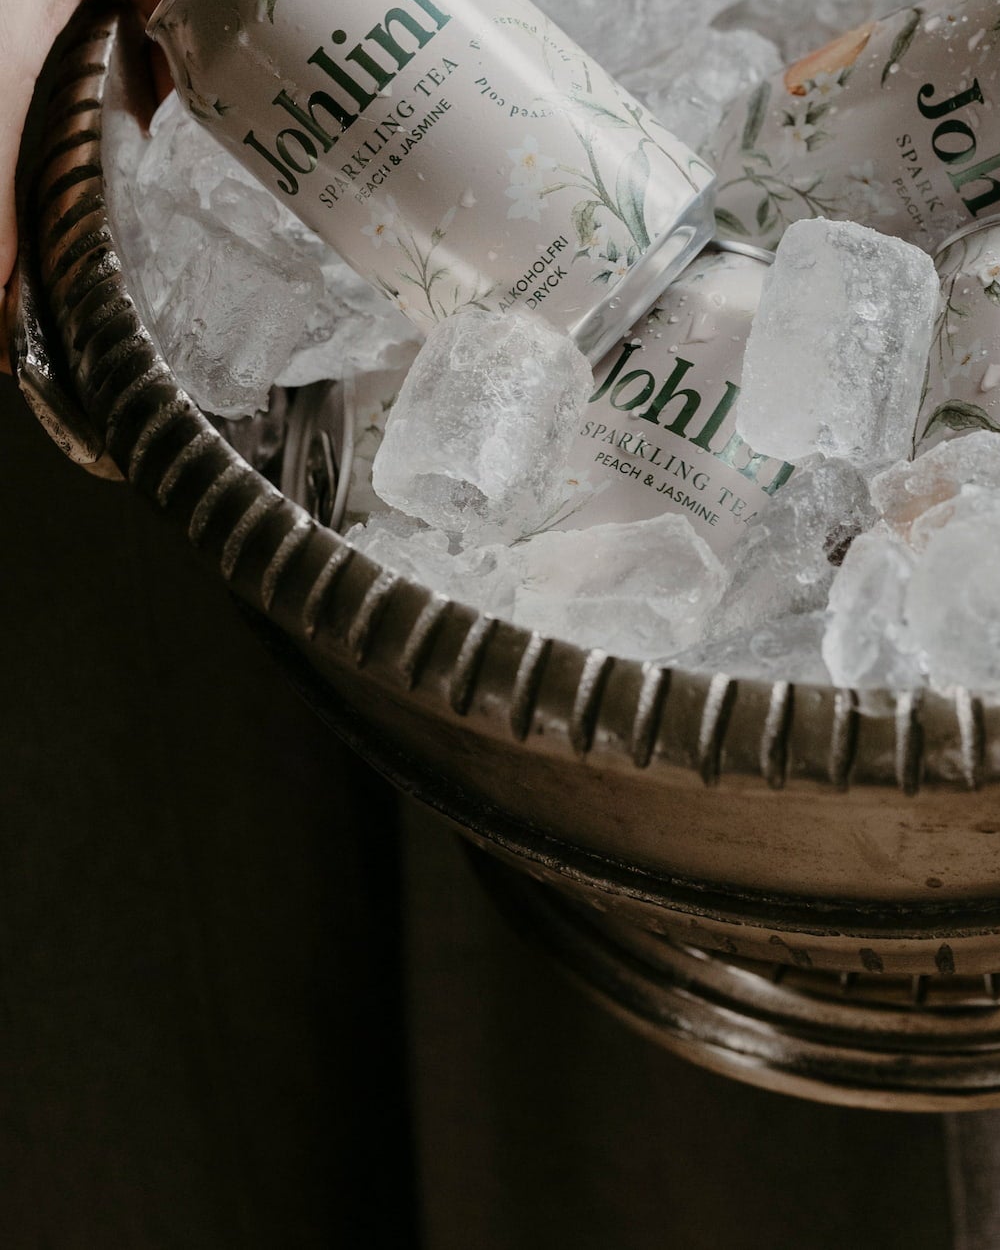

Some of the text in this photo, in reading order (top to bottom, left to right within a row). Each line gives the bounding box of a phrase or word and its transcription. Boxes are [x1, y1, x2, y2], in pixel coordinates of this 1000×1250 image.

[474, 77, 506, 107] cold
[318, 57, 459, 209] SPARKLING TEA
[353, 98, 452, 205] PEACH & JASMINE
[498, 235, 569, 313] ALKOHOLFRI DRYCK
[580, 421, 711, 491] SPARKLING
[594, 452, 720, 527] PEACH & JASMINE
